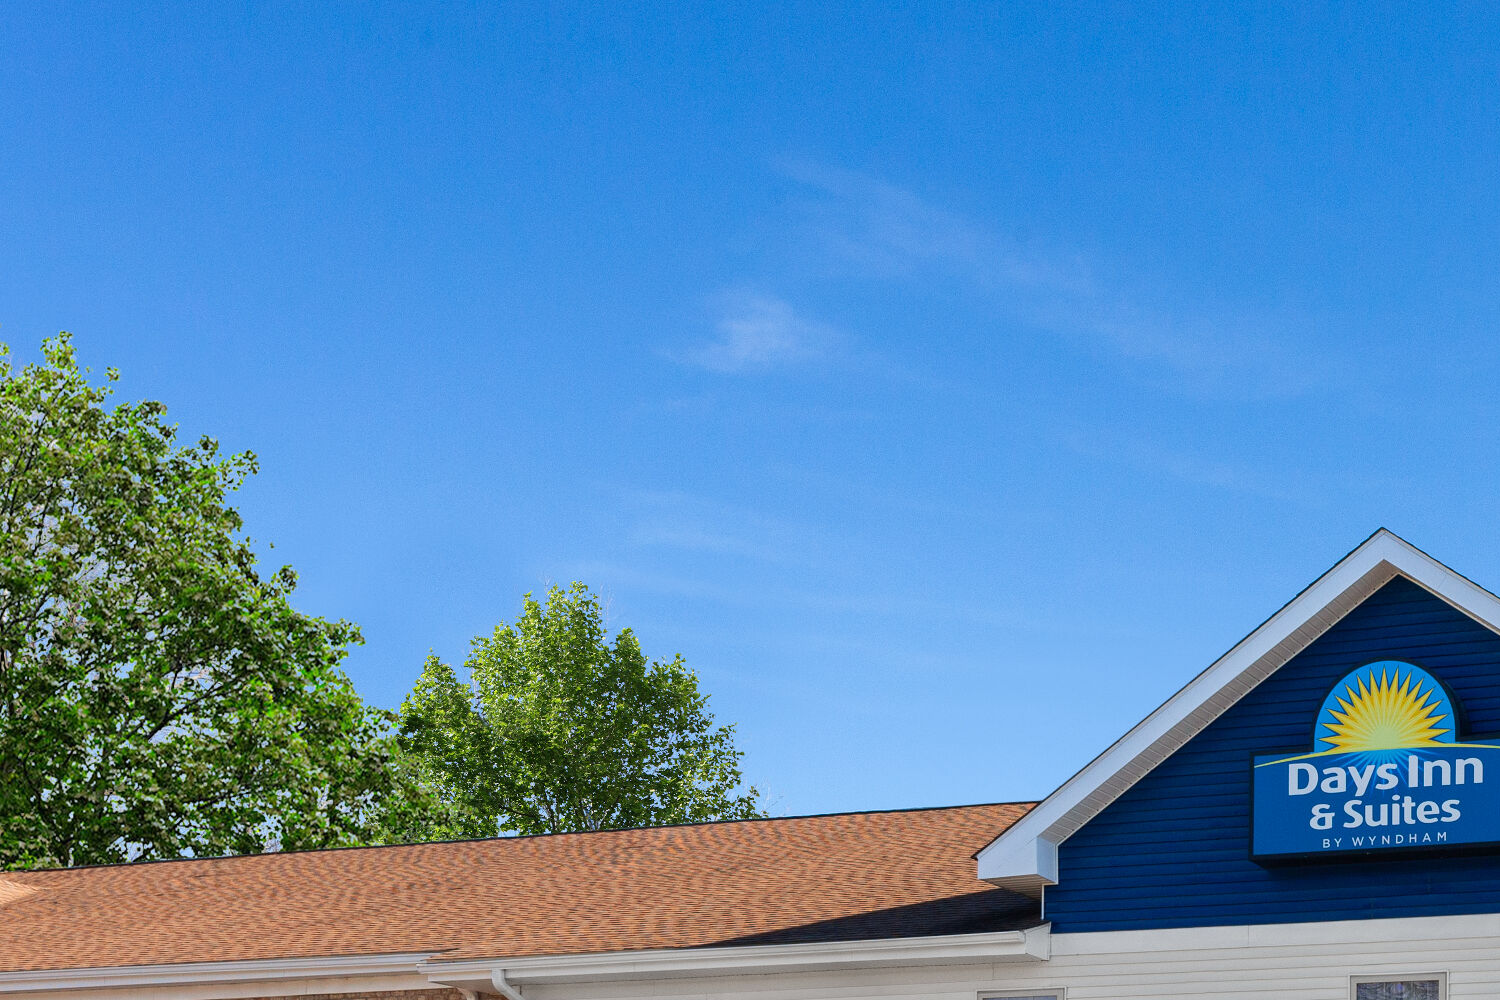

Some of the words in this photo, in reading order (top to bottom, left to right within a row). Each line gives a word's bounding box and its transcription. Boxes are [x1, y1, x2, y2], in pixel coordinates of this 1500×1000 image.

[1288, 762, 1398, 796] Days
[1409, 755, 1484, 788] Inn
[1309, 804, 1335, 830] &
[1343, 794, 1461, 828] Suites
[1322, 837, 1342, 848] BY
[1352, 832, 1447, 846] WYNDHAM
